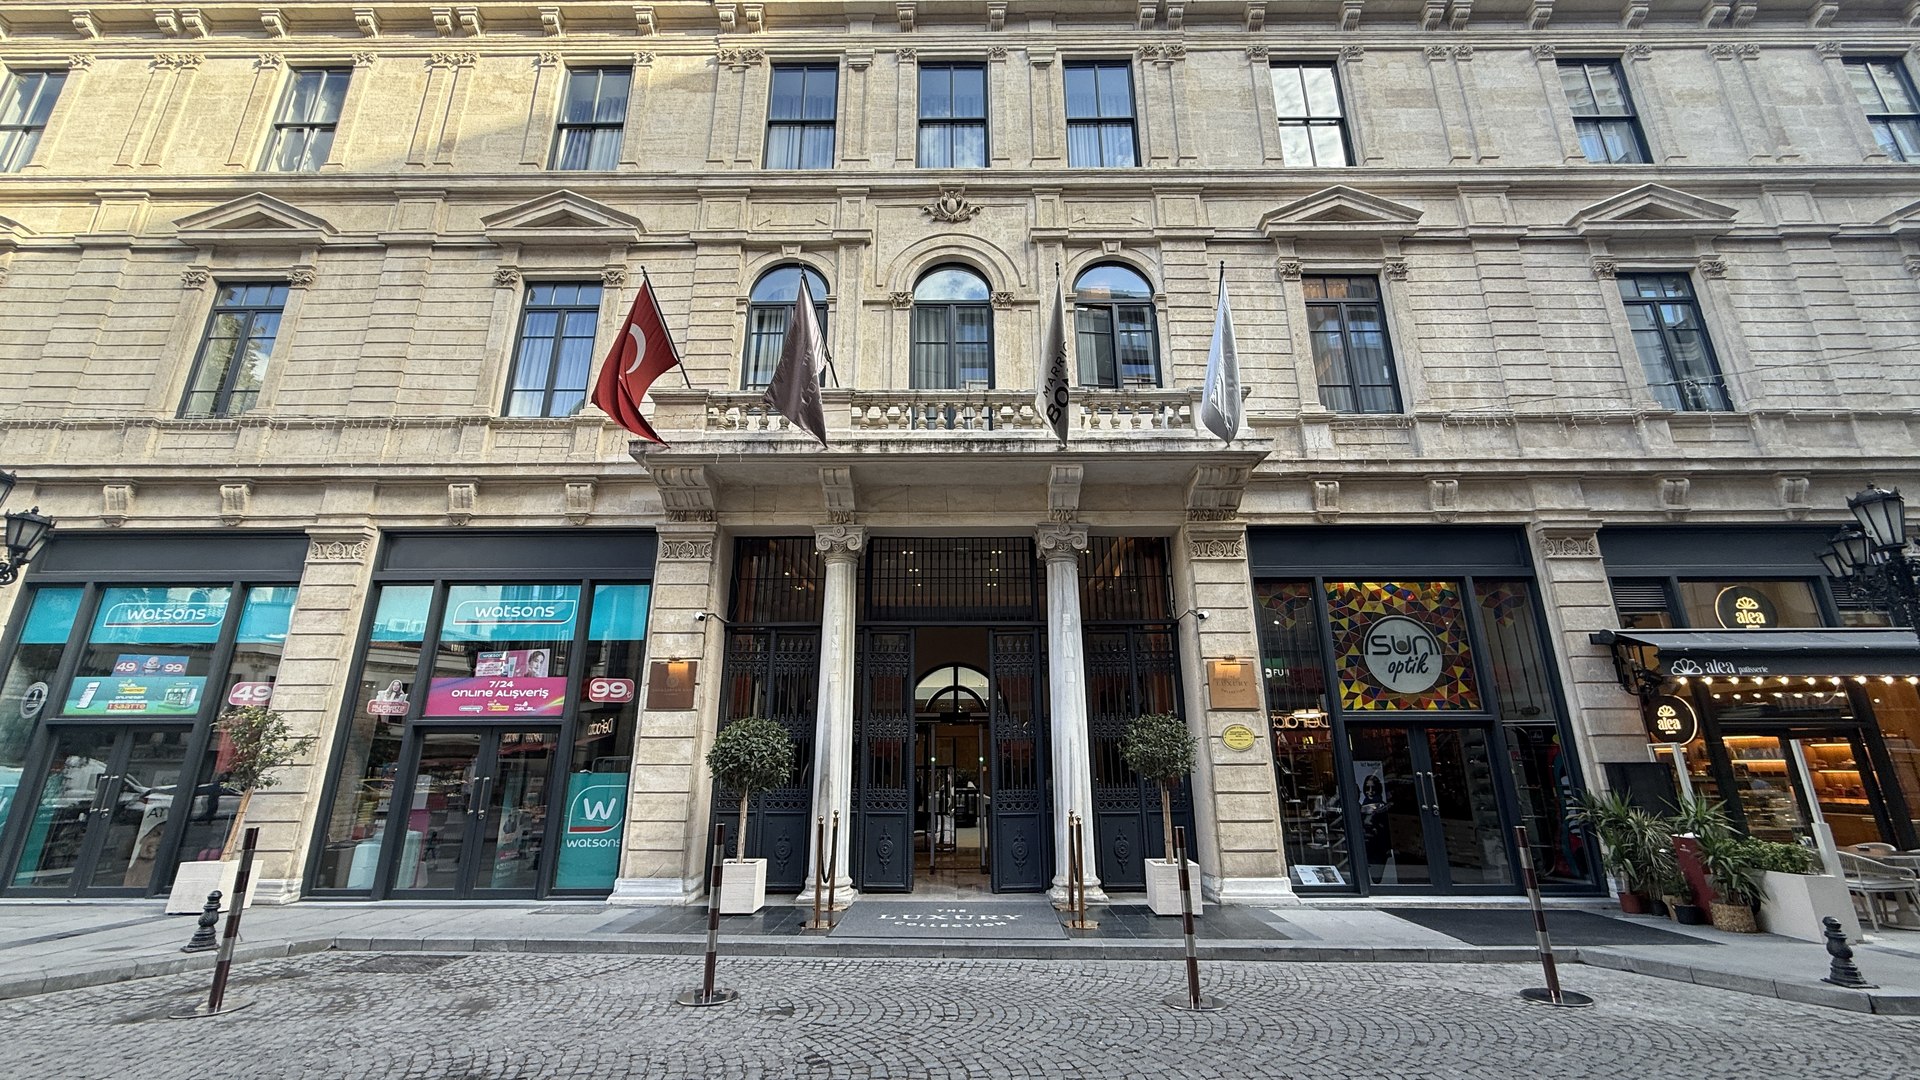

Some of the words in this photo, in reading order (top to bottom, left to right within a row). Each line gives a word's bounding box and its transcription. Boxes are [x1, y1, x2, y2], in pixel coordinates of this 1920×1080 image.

[127, 607, 207, 620] watsons
[475, 605, 555, 618] watsons
[1735, 609, 1766, 624] alea
[1388, 652, 1429, 683] optik
[1705, 659, 1736, 674] alea
[1738, 666, 1769, 675] patisserie
[232, 685, 273, 702] 49
[1657, 717, 1682, 730] alea
[583, 797, 616, 820] W
[566, 837, 621, 848] watsons
